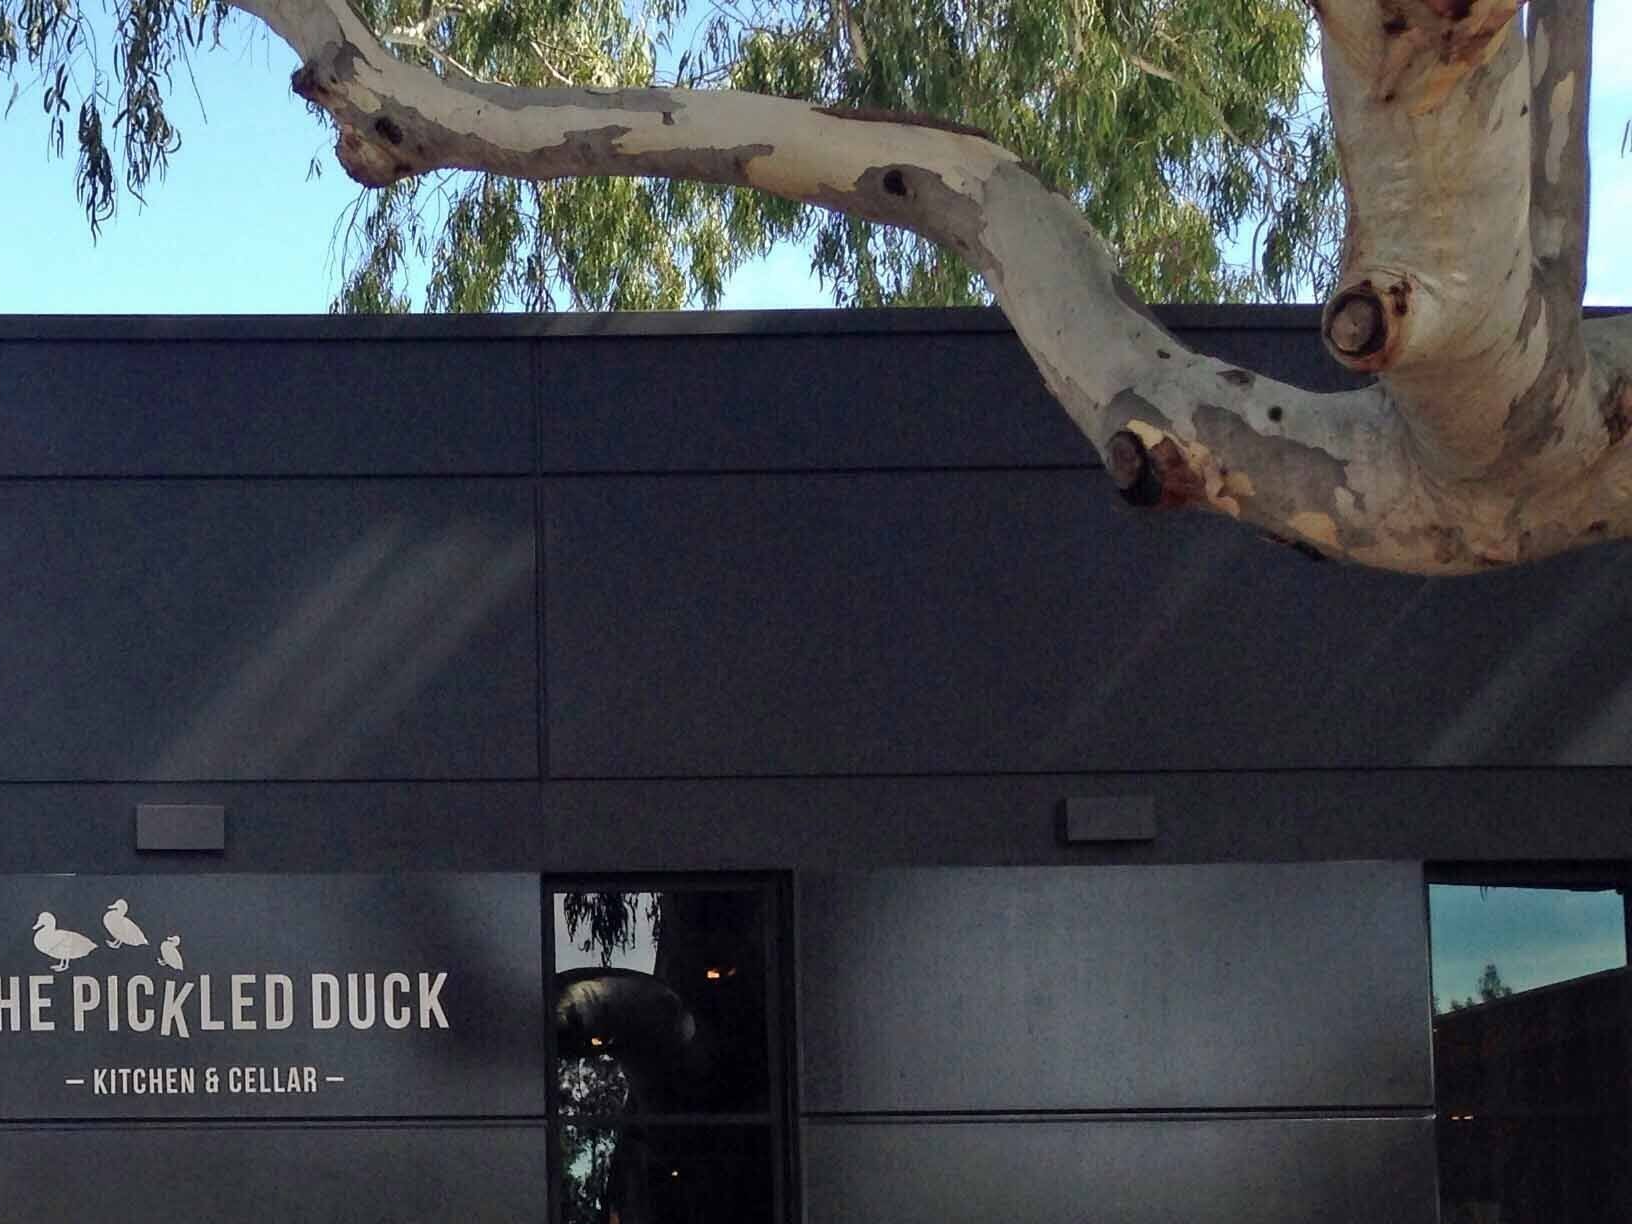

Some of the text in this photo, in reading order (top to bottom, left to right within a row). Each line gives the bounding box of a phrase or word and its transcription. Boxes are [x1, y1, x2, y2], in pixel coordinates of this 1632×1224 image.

[73, 974, 294, 1038] PICKLED
[312, 972, 450, 1029] DUCK
[93, 1066, 318, 1094] KITCHEN & CELLAR
